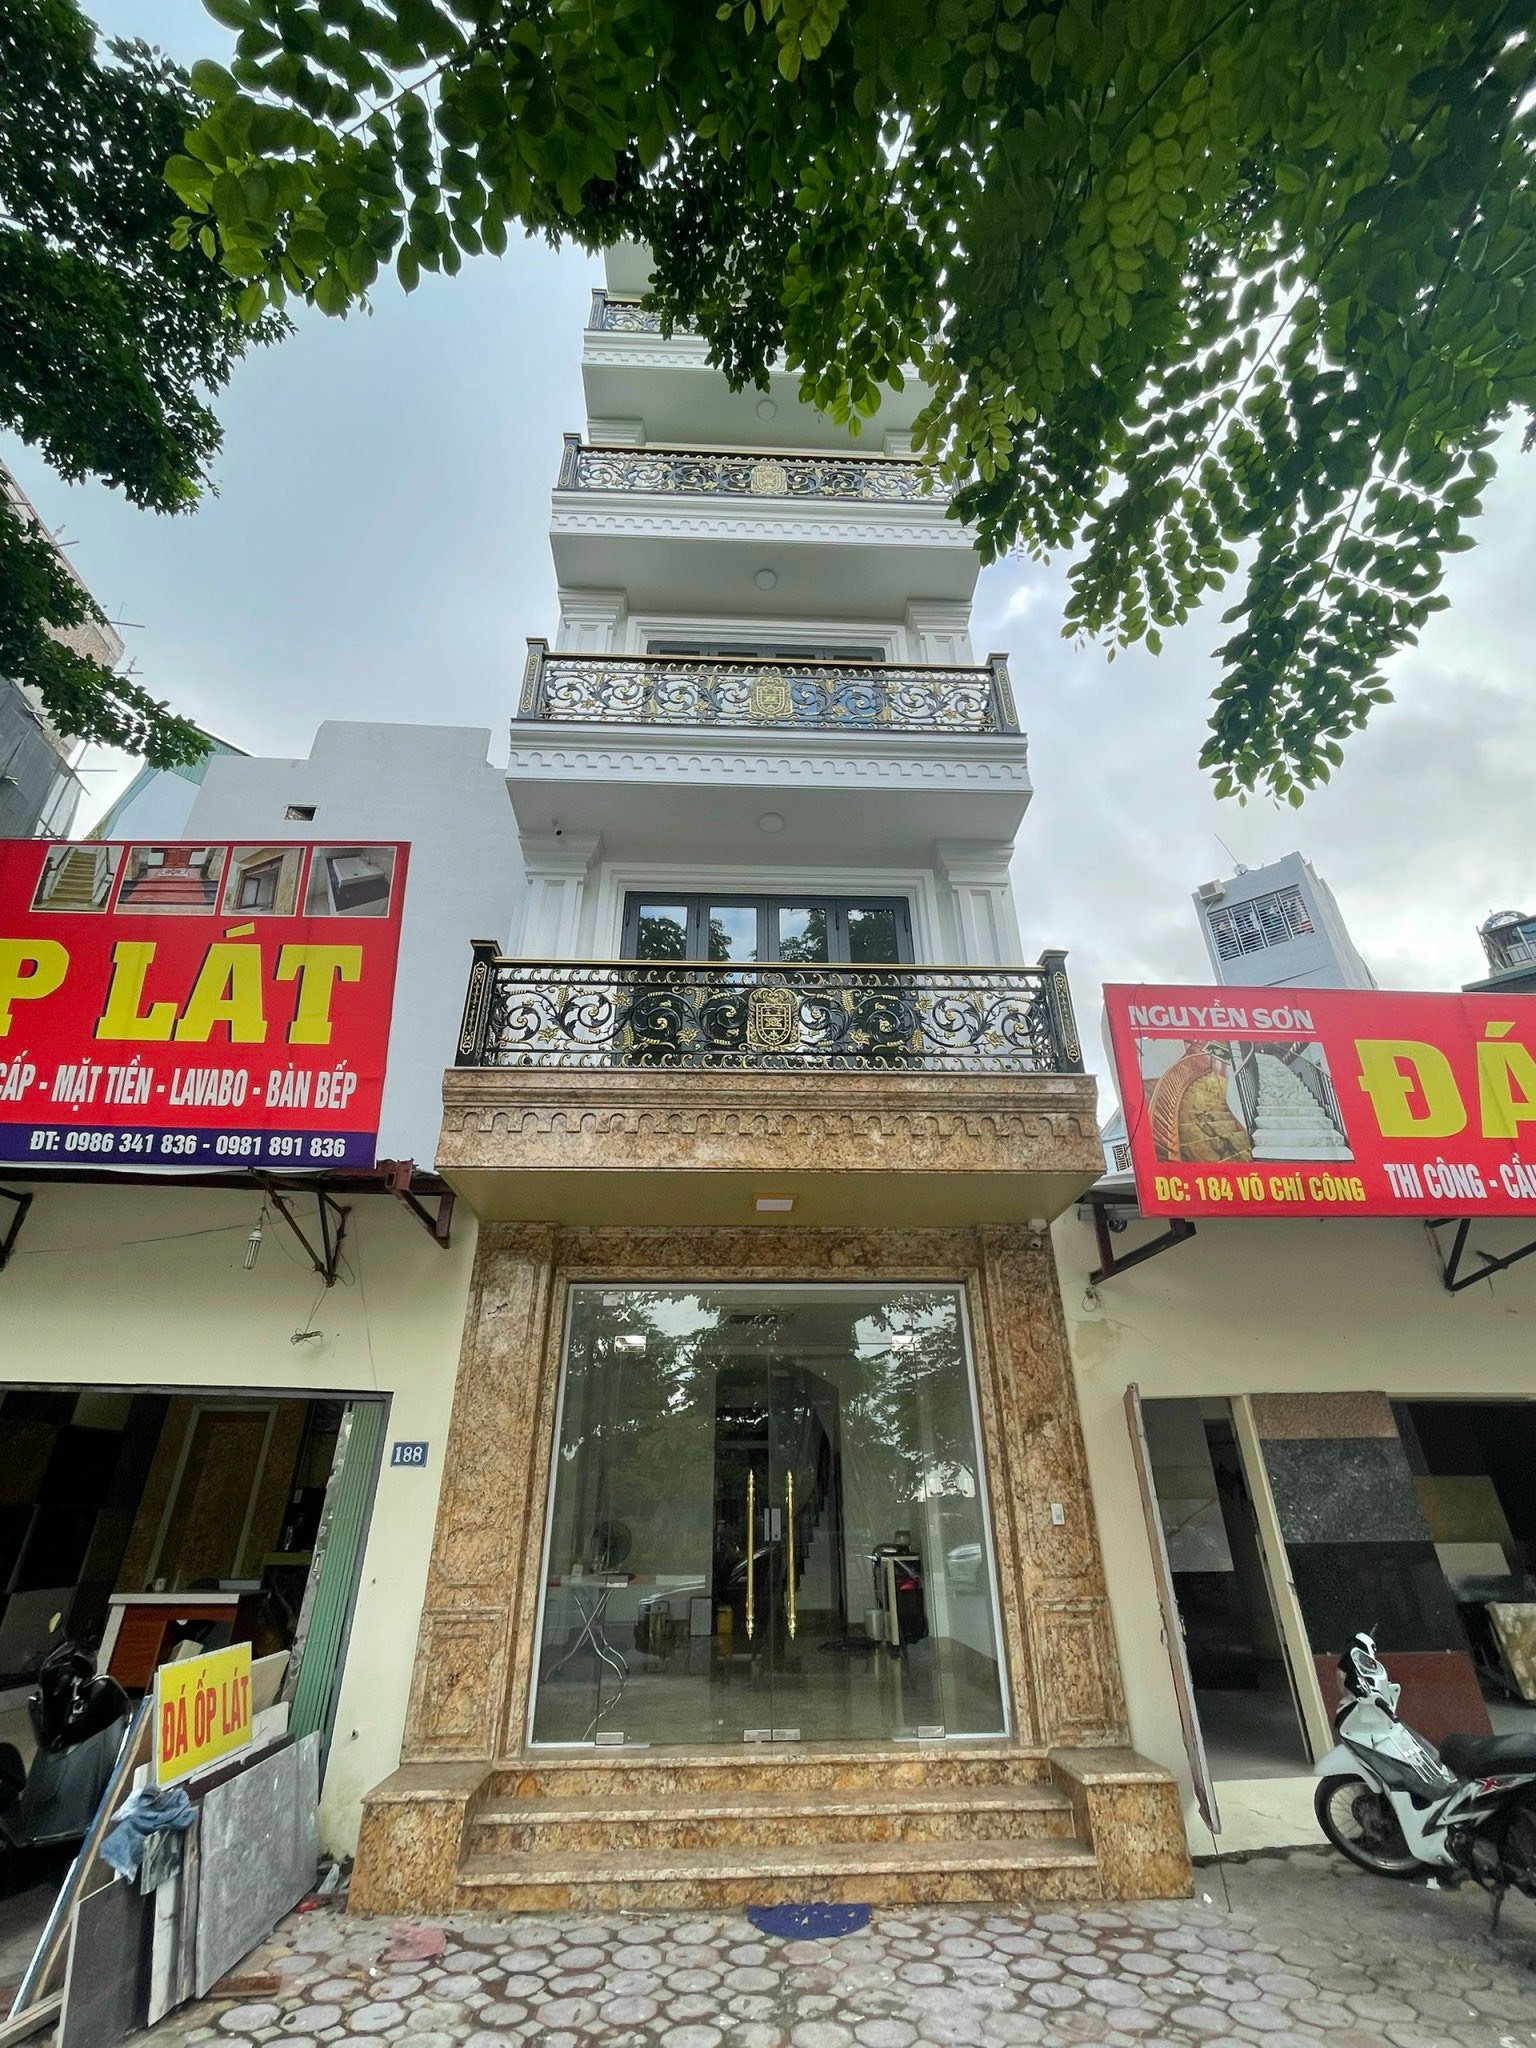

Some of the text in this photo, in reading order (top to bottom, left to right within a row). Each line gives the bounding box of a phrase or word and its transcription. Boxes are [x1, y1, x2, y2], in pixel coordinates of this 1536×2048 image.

[94, 922, 363, 1044] LÁT
[1128, 999, 1315, 1029] NGUYỄN SƠN
[51, 1057, 103, 1112] MẶT
[104, 1054, 154, 1105] TIỀN
[169, 1068, 249, 1107] LAVABO
[265, 1062, 313, 1108] BÀN
[314, 1059, 358, 1109] BẾP
[1354, 1021, 1536, 1139] ĐÁ
[30, 1131, 60, 1151] ĐT:
[64, 1131, 115, 1152] 0986
[118, 1133, 153, 1153] 341
[160, 1134, 198, 1155] 836
[215, 1135, 262, 1156] 0981
[268, 1136, 303, 1156] 891
[309, 1137, 346, 1158] 836
[1154, 1171, 1367, 1202] ĐC: 184 VÕ CHÍ CÔNG
[1382, 1163, 1425, 1198] THI
[1423, 1156, 1488, 1199] CÔNG
[394, 1446, 423, 1463] 188
[162, 1666, 249, 1763] ĐÁ ỐP LÁT
